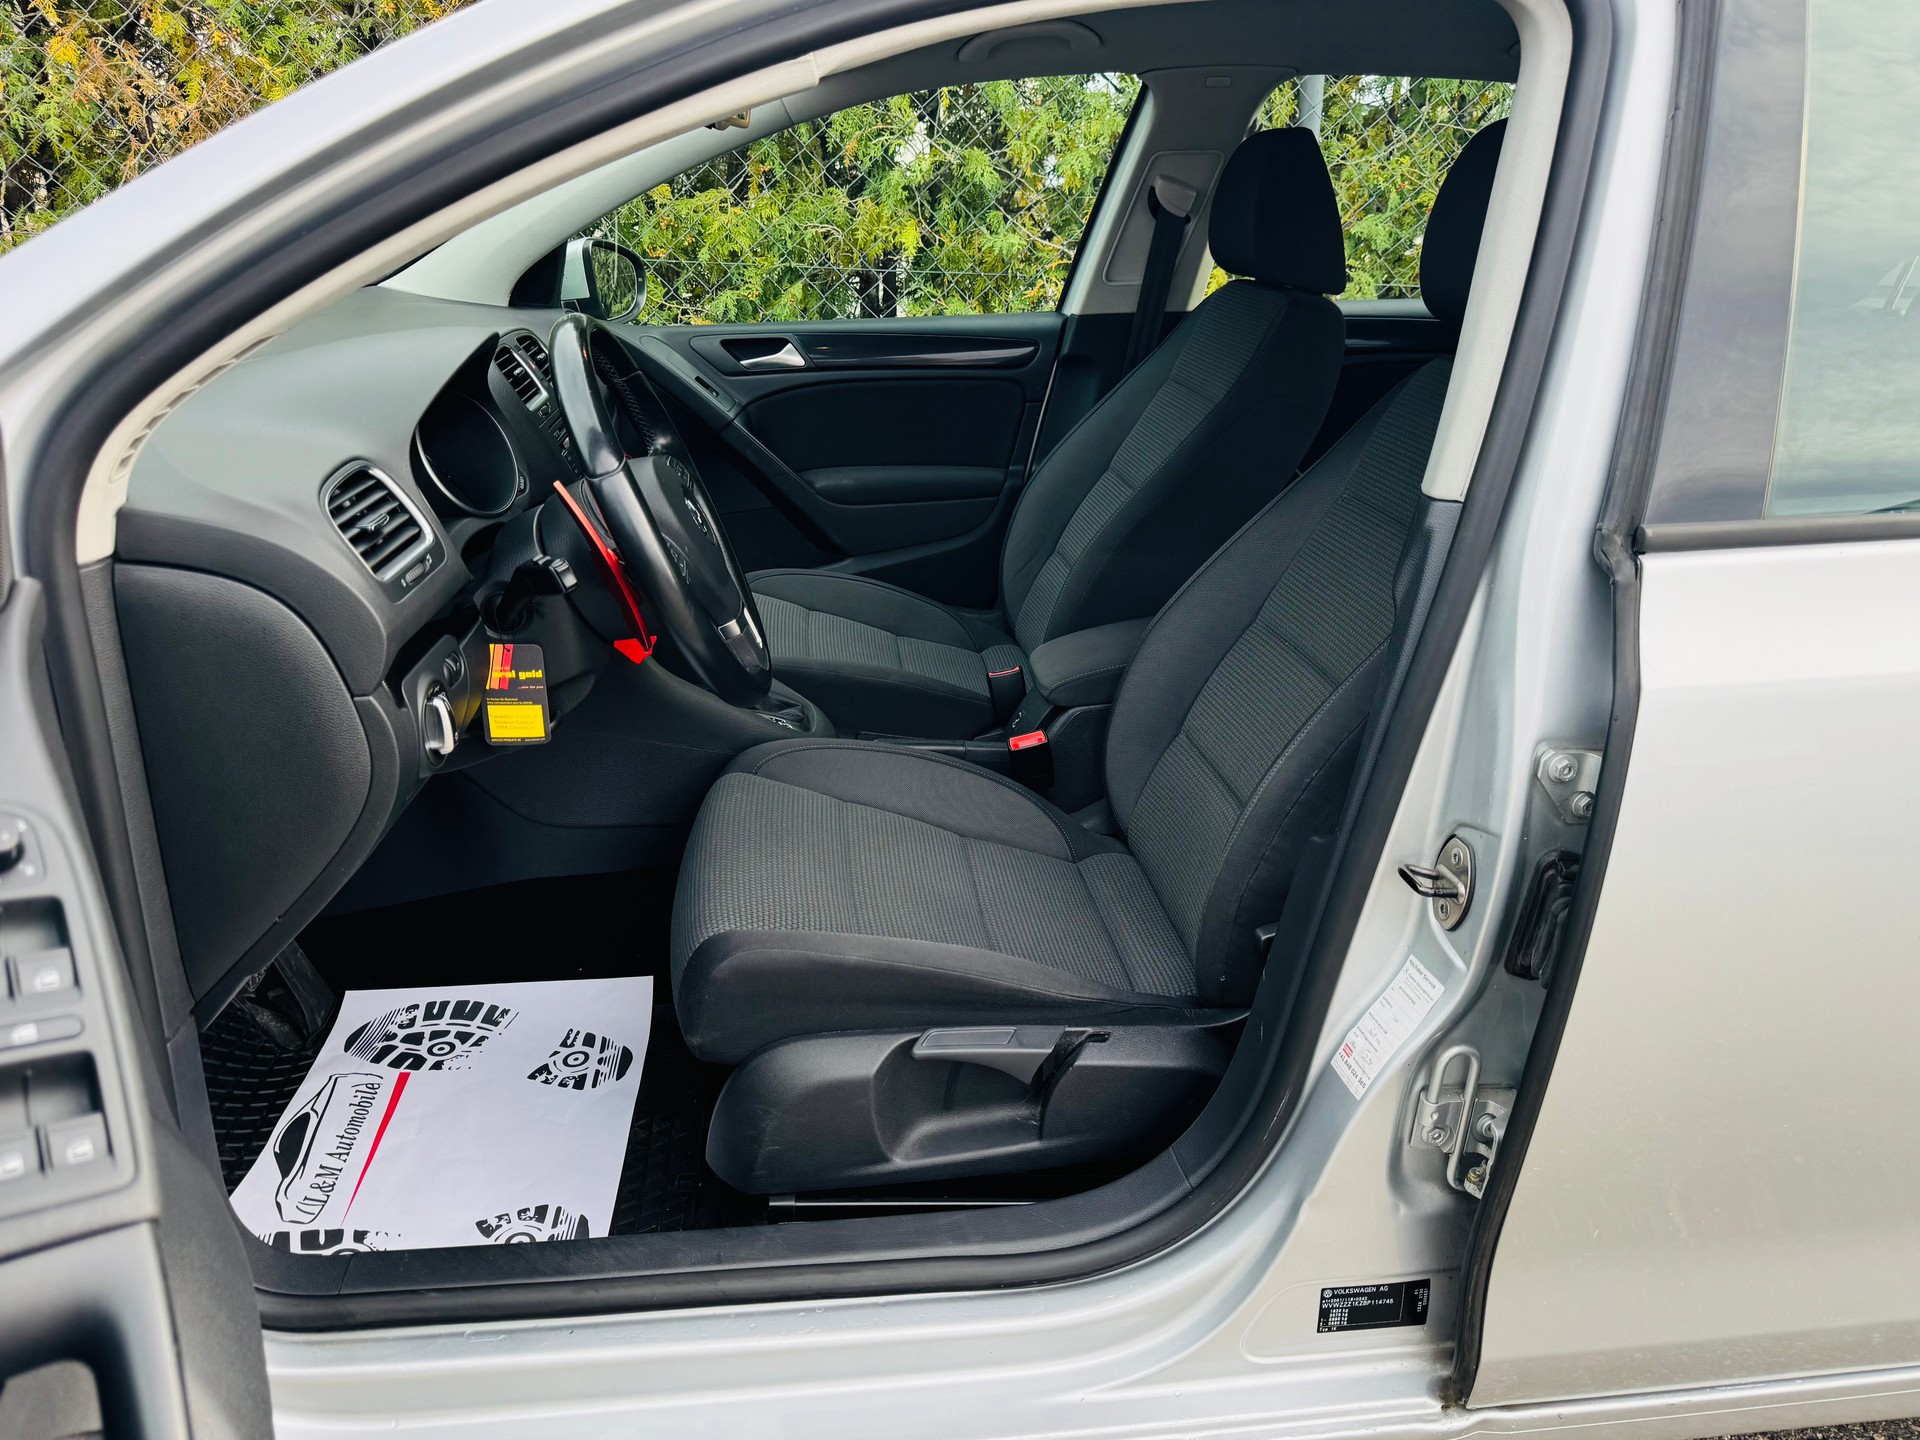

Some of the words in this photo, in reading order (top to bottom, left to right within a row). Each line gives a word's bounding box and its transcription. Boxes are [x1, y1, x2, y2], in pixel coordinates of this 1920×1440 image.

[518, 669, 543, 680] gold
[303, 1164, 343, 1203] L&M
[325, 1082, 381, 1163] Automobile
[1333, 1286, 1377, 1295] VOLKSWAGEN
